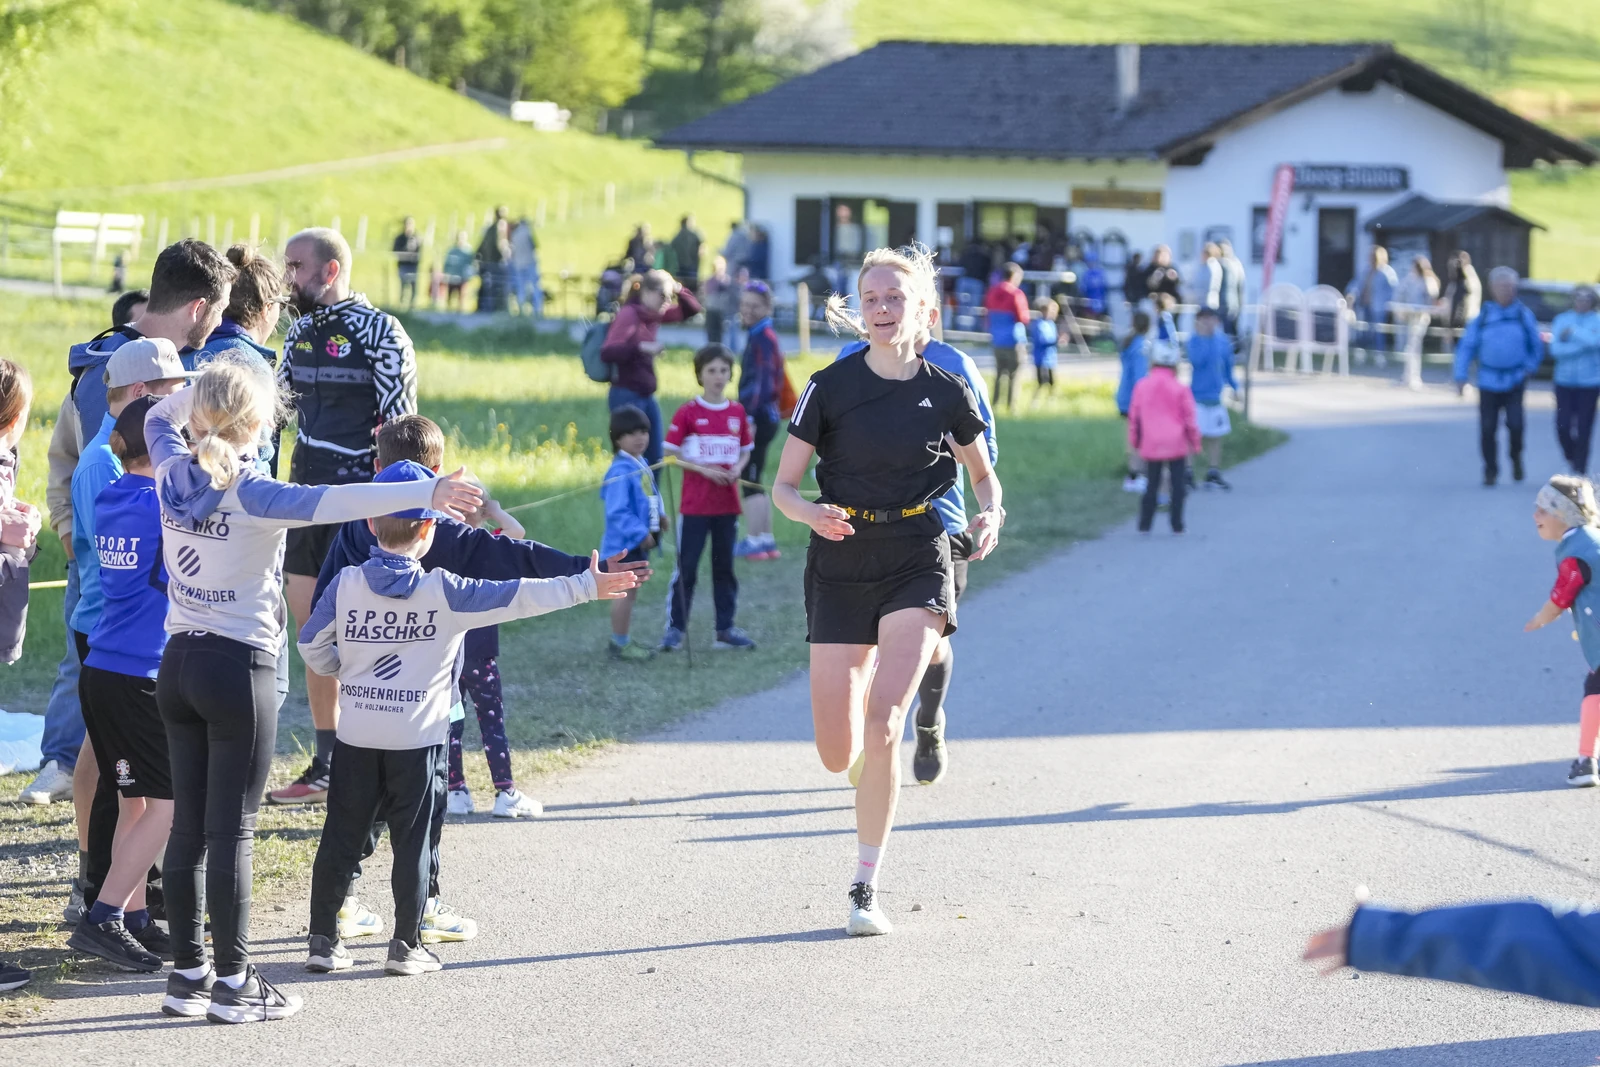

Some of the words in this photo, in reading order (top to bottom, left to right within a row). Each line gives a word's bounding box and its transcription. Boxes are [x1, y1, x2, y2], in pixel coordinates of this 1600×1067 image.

[346, 609, 438, 625] SPORT
[344, 624, 437, 640] HASCHKO
[340, 683, 428, 702] POSCHENRIEDER
[354, 701, 363, 710] DIE
[365, 703, 404, 713] HOLZMACHER
